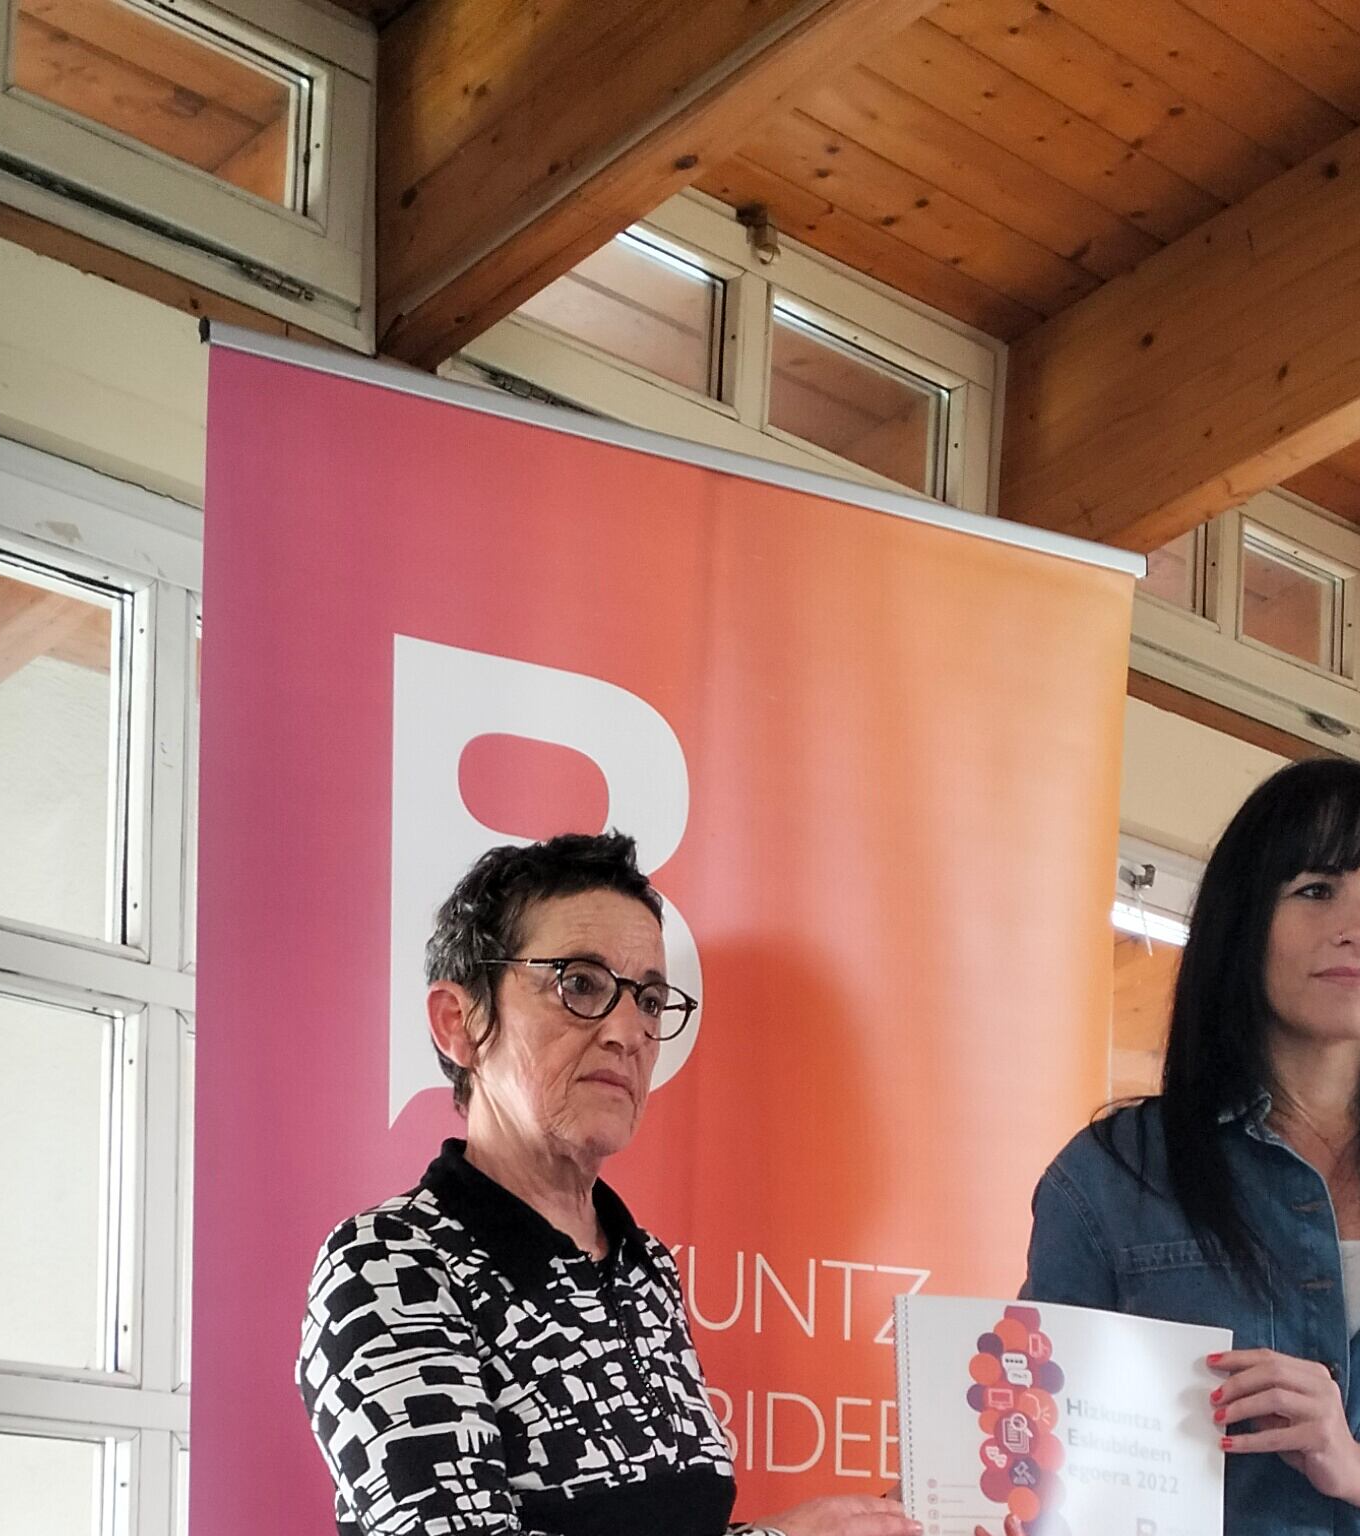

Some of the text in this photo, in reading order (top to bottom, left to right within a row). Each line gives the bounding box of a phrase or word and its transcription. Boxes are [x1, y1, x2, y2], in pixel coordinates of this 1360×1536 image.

[670, 1245, 931, 1345] UNTZ
[1066, 1397, 1162, 1432] Hizkuntza
[1067, 1428, 1172, 1464] Eskubideen
[1068, 1464, 1180, 1494] egoera 2022
